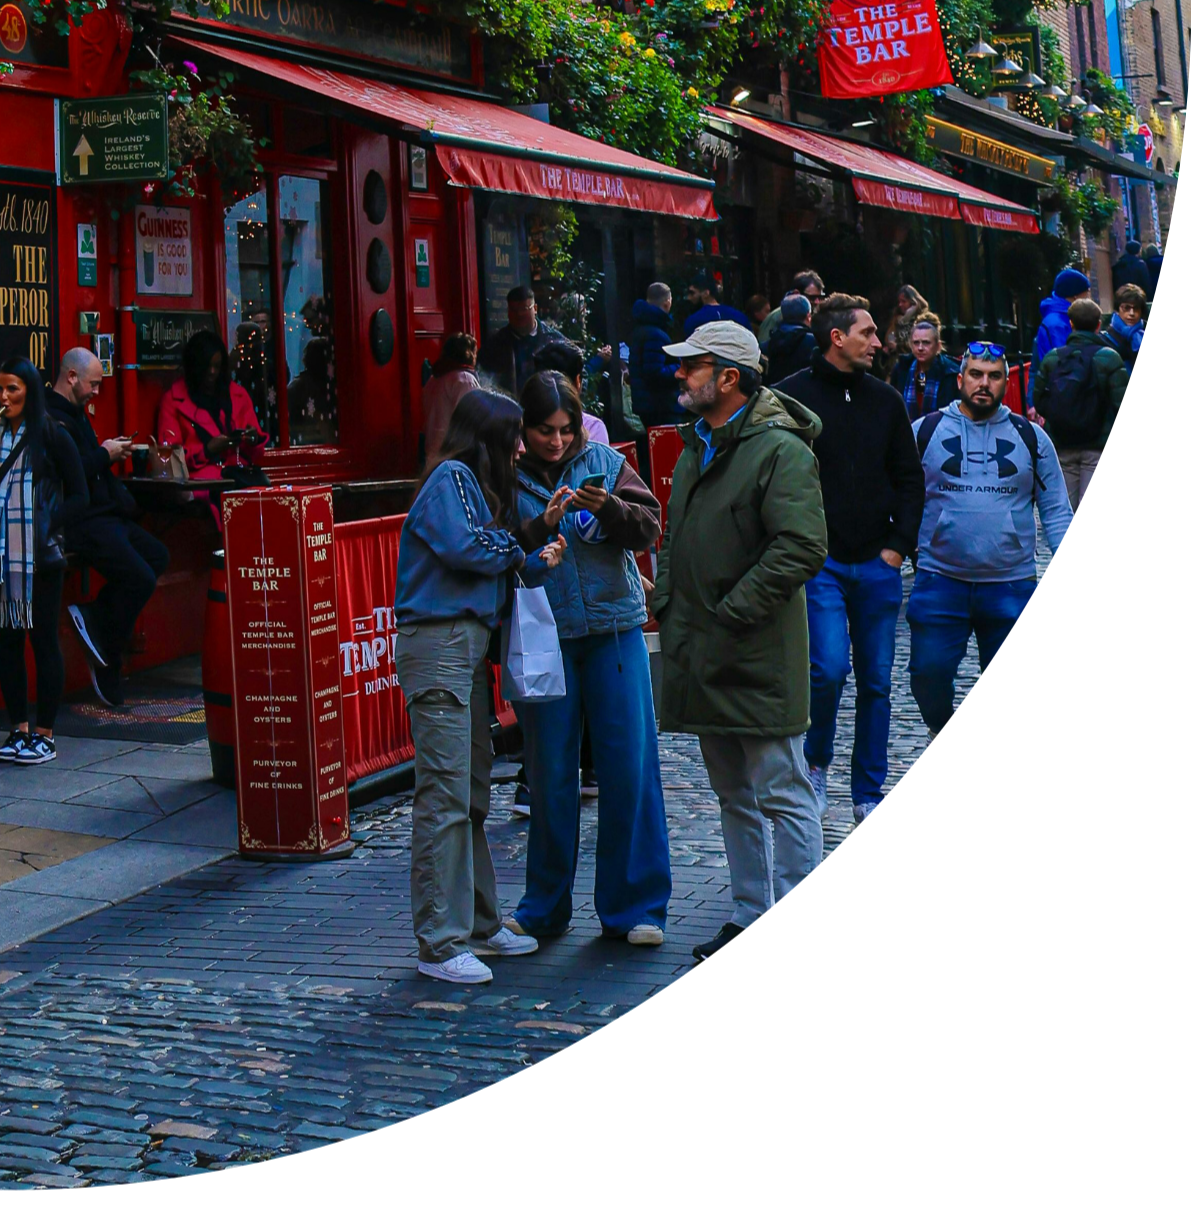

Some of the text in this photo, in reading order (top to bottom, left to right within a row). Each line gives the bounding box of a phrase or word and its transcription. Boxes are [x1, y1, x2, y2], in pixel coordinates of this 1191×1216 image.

[854, 4, 898, 23] THE
[1, 15, 22, 43] 48
[827, 12, 932, 47] TEMPLE
[854, 40, 910, 65] BAR
[104, 135, 150, 144] IRELAND'S
[104, 144, 144, 153] LARGEST
[104, 153, 145, 163] WHISKEY
[104, 161, 160, 171] COLLECTION
[539, 164, 625, 199] THE TEMPLE BAR
[20, 199, 49, 234] 1840
[137, 212, 188, 238] GUINNESS
[157, 244, 187, 258] IS GOOD
[13, 244, 48, 284] THE
[158, 262, 188, 276] FOR YOU
[29, 332, 49, 370] OF
[938, 484, 1018, 495] UNDER ARMOUR
[313, 522, 324, 532] THE
[306, 533, 332, 548] TEMPLE
[253, 556, 274, 565] THE
[314, 548, 327, 562] BAR
[238, 567, 291, 578] TEMPLE
[252, 580, 279, 591] BAR
[314, 600, 332, 610] OFFICIAL
[311, 611, 336, 624] TEMPLE BAR
[311, 624, 337, 636] MERCHANDISE
[355, 623, 366, 631] Est.
[314, 685, 339, 699] CHAMPAGNE
[323, 700, 333, 709] AND
[319, 711, 338, 723] OYSTERS
[320, 760, 342, 774] PURVEYOR
[328, 776, 335, 785] OF
[319, 787, 345, 802] FINE DRINKS
